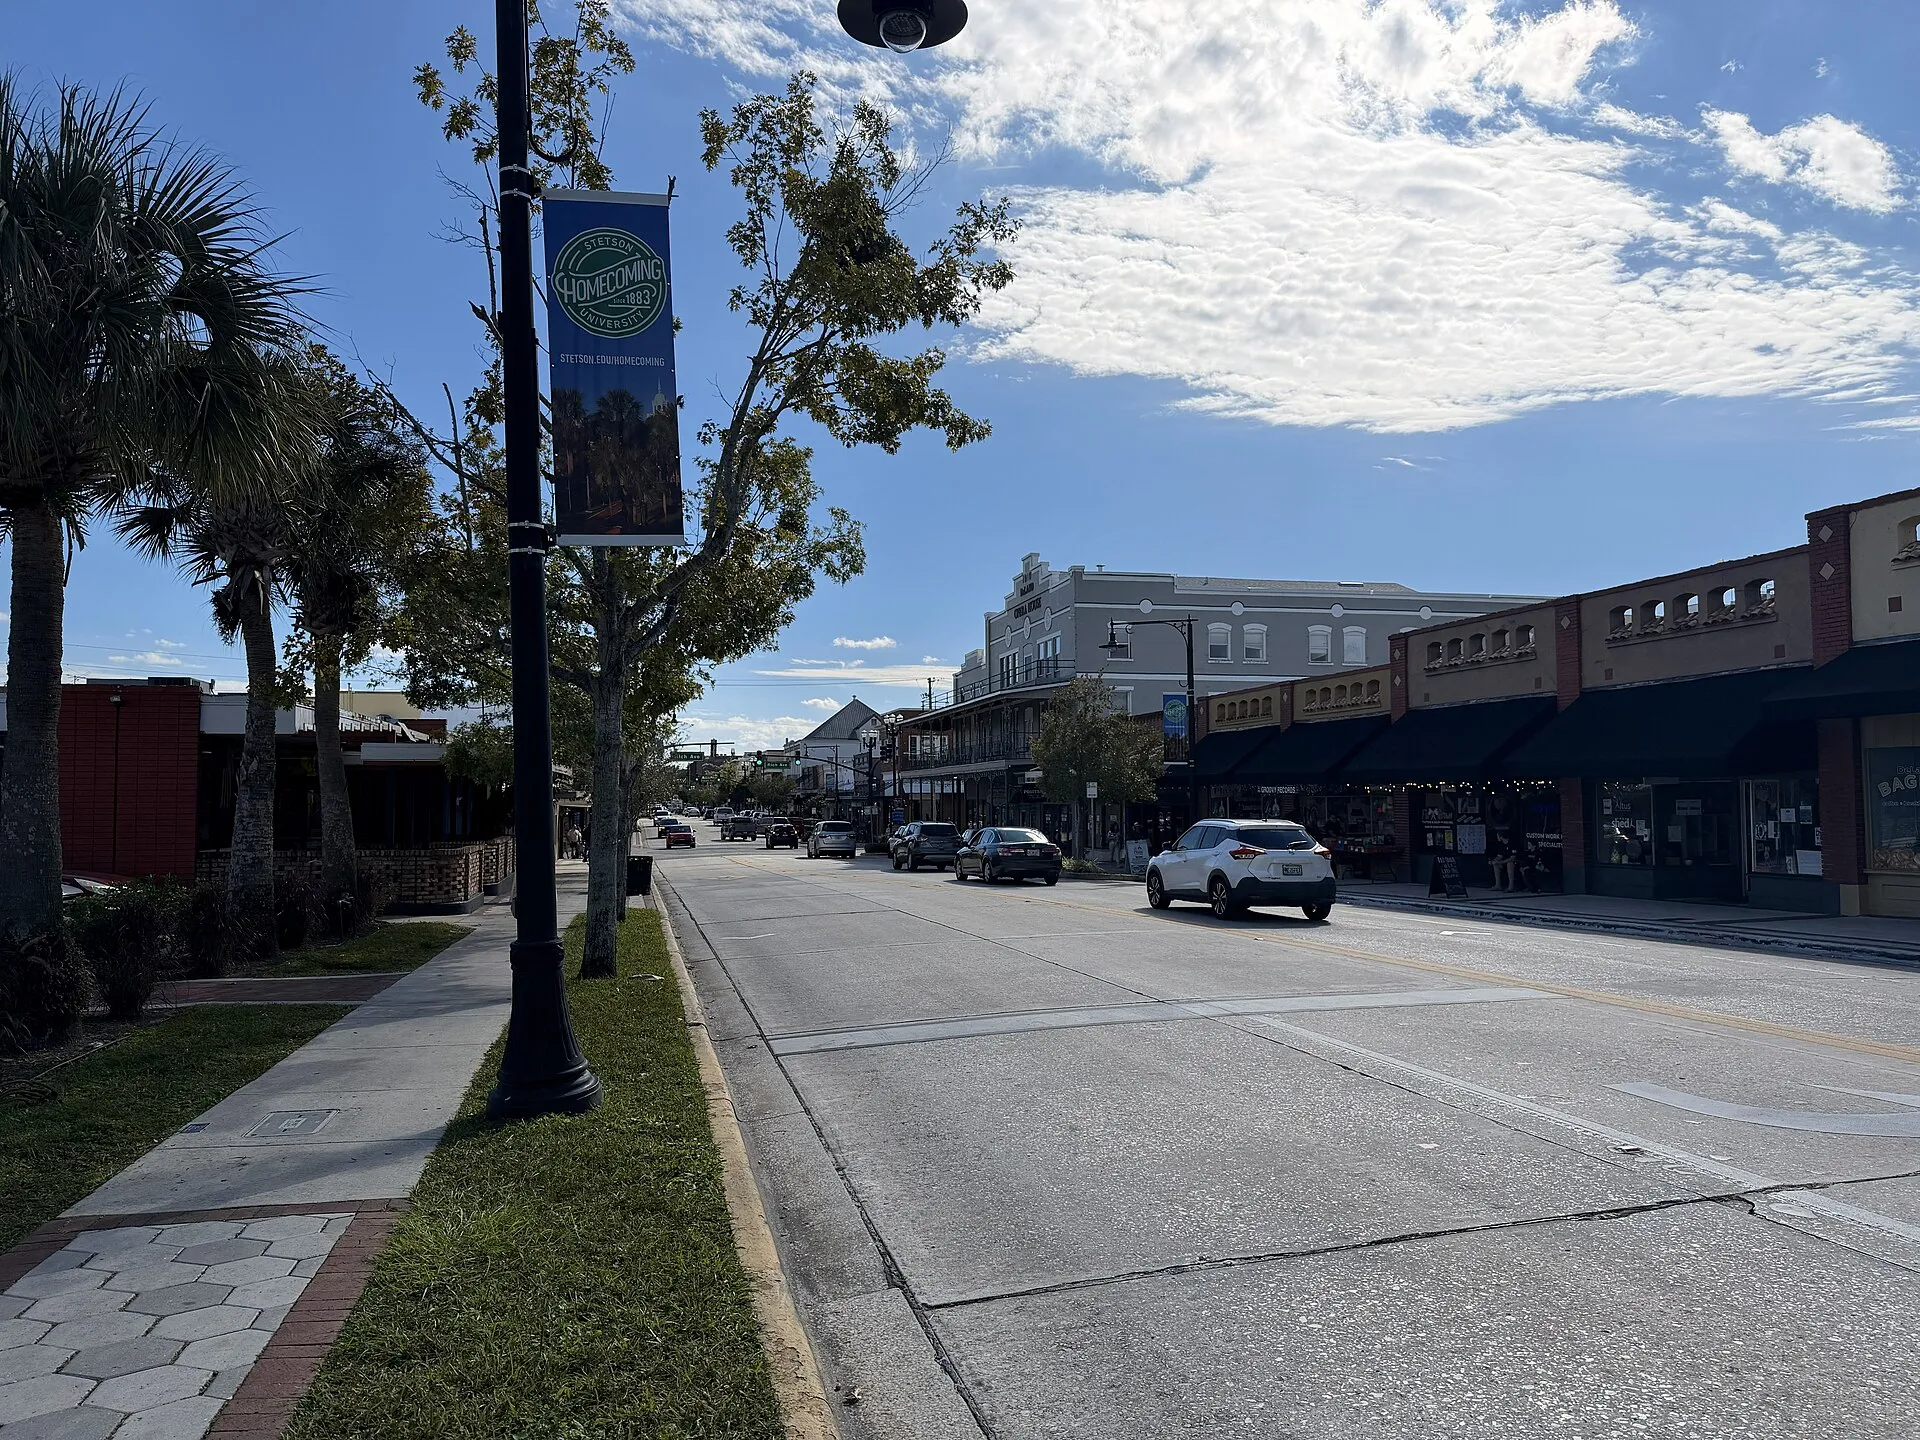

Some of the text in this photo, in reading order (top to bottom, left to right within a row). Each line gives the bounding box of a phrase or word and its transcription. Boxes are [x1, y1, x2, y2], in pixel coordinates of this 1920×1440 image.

[584, 237, 634, 252] STETSON
[555, 259, 661, 303] HOMECOMING
[613, 289, 651, 304] since 1883
[580, 308, 644, 328] UNIVERSITY
[560, 354, 665, 366] STETSON.EDU/HOMECOMING
[1277, 786, 1296, 794] RECORDS
[1877, 774, 1920, 798] BAG
